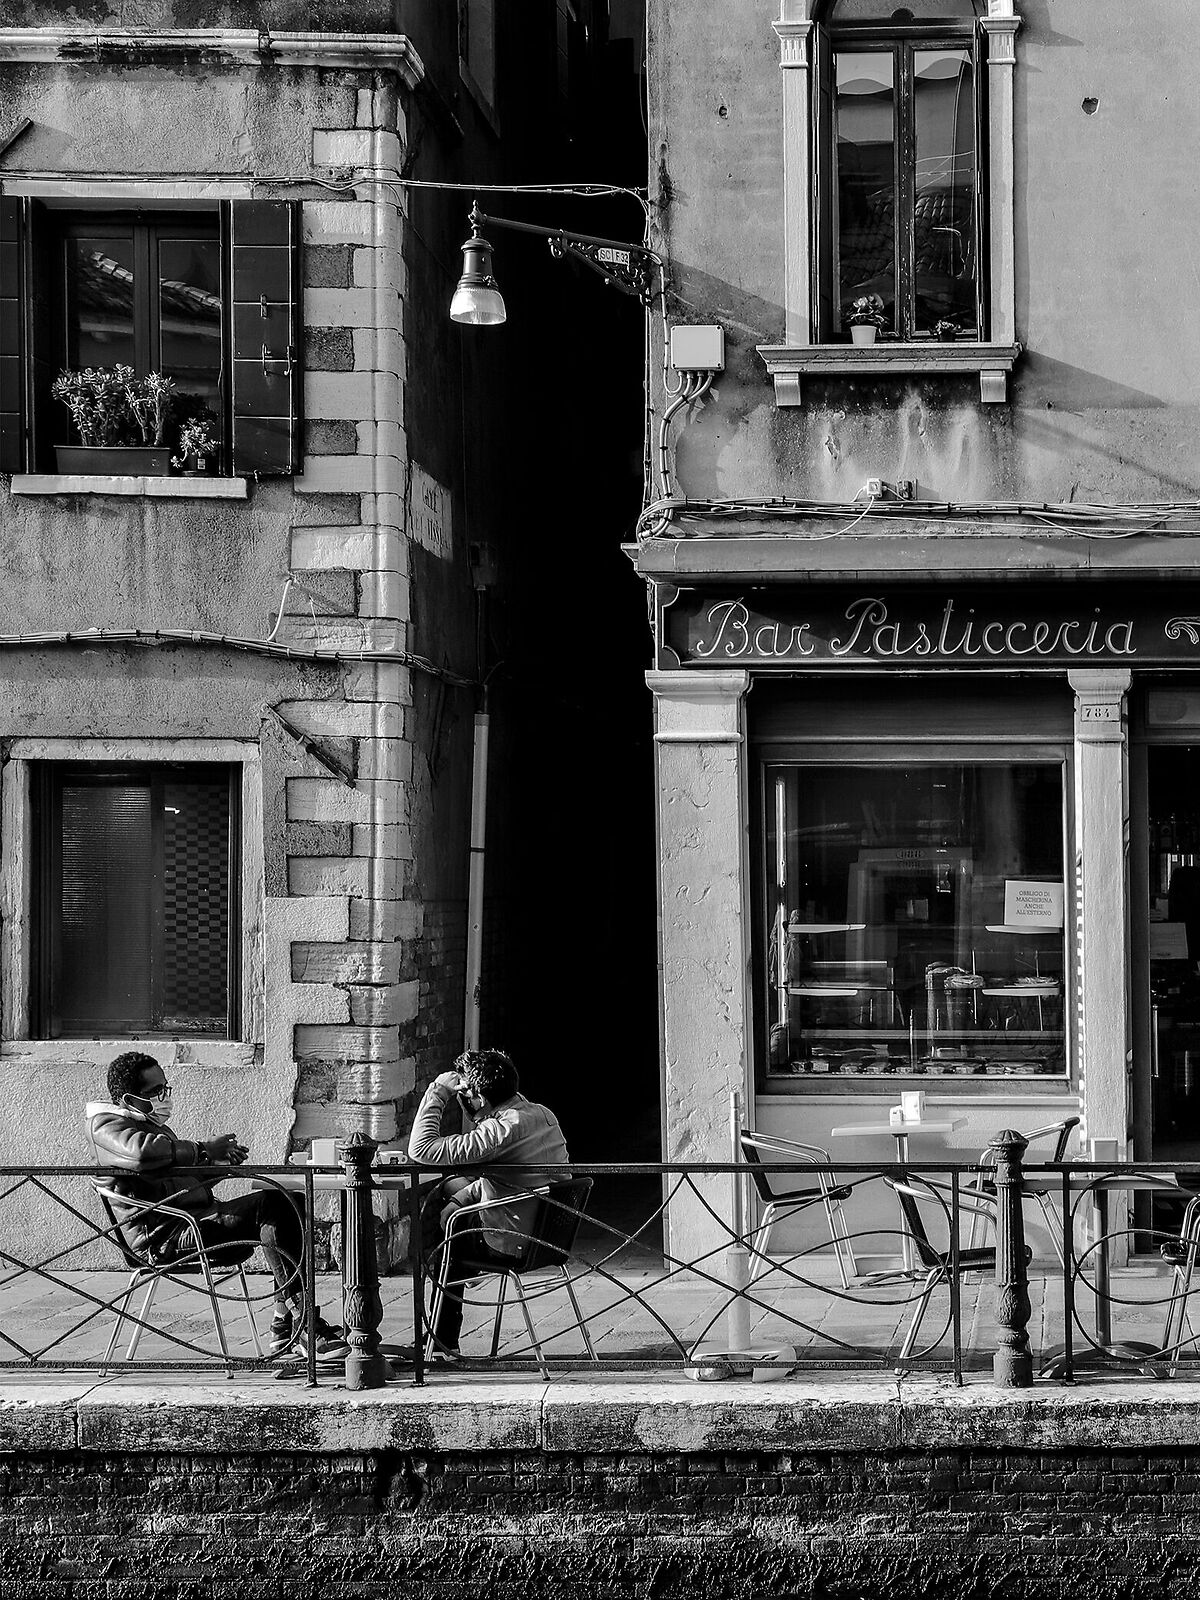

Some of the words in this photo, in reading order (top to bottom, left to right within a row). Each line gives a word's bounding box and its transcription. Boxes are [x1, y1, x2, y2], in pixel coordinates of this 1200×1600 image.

[696, 596, 816, 658] Bar
[829, 597, 1138, 656] Pasticceria
[1086, 708, 1110, 718] 784
